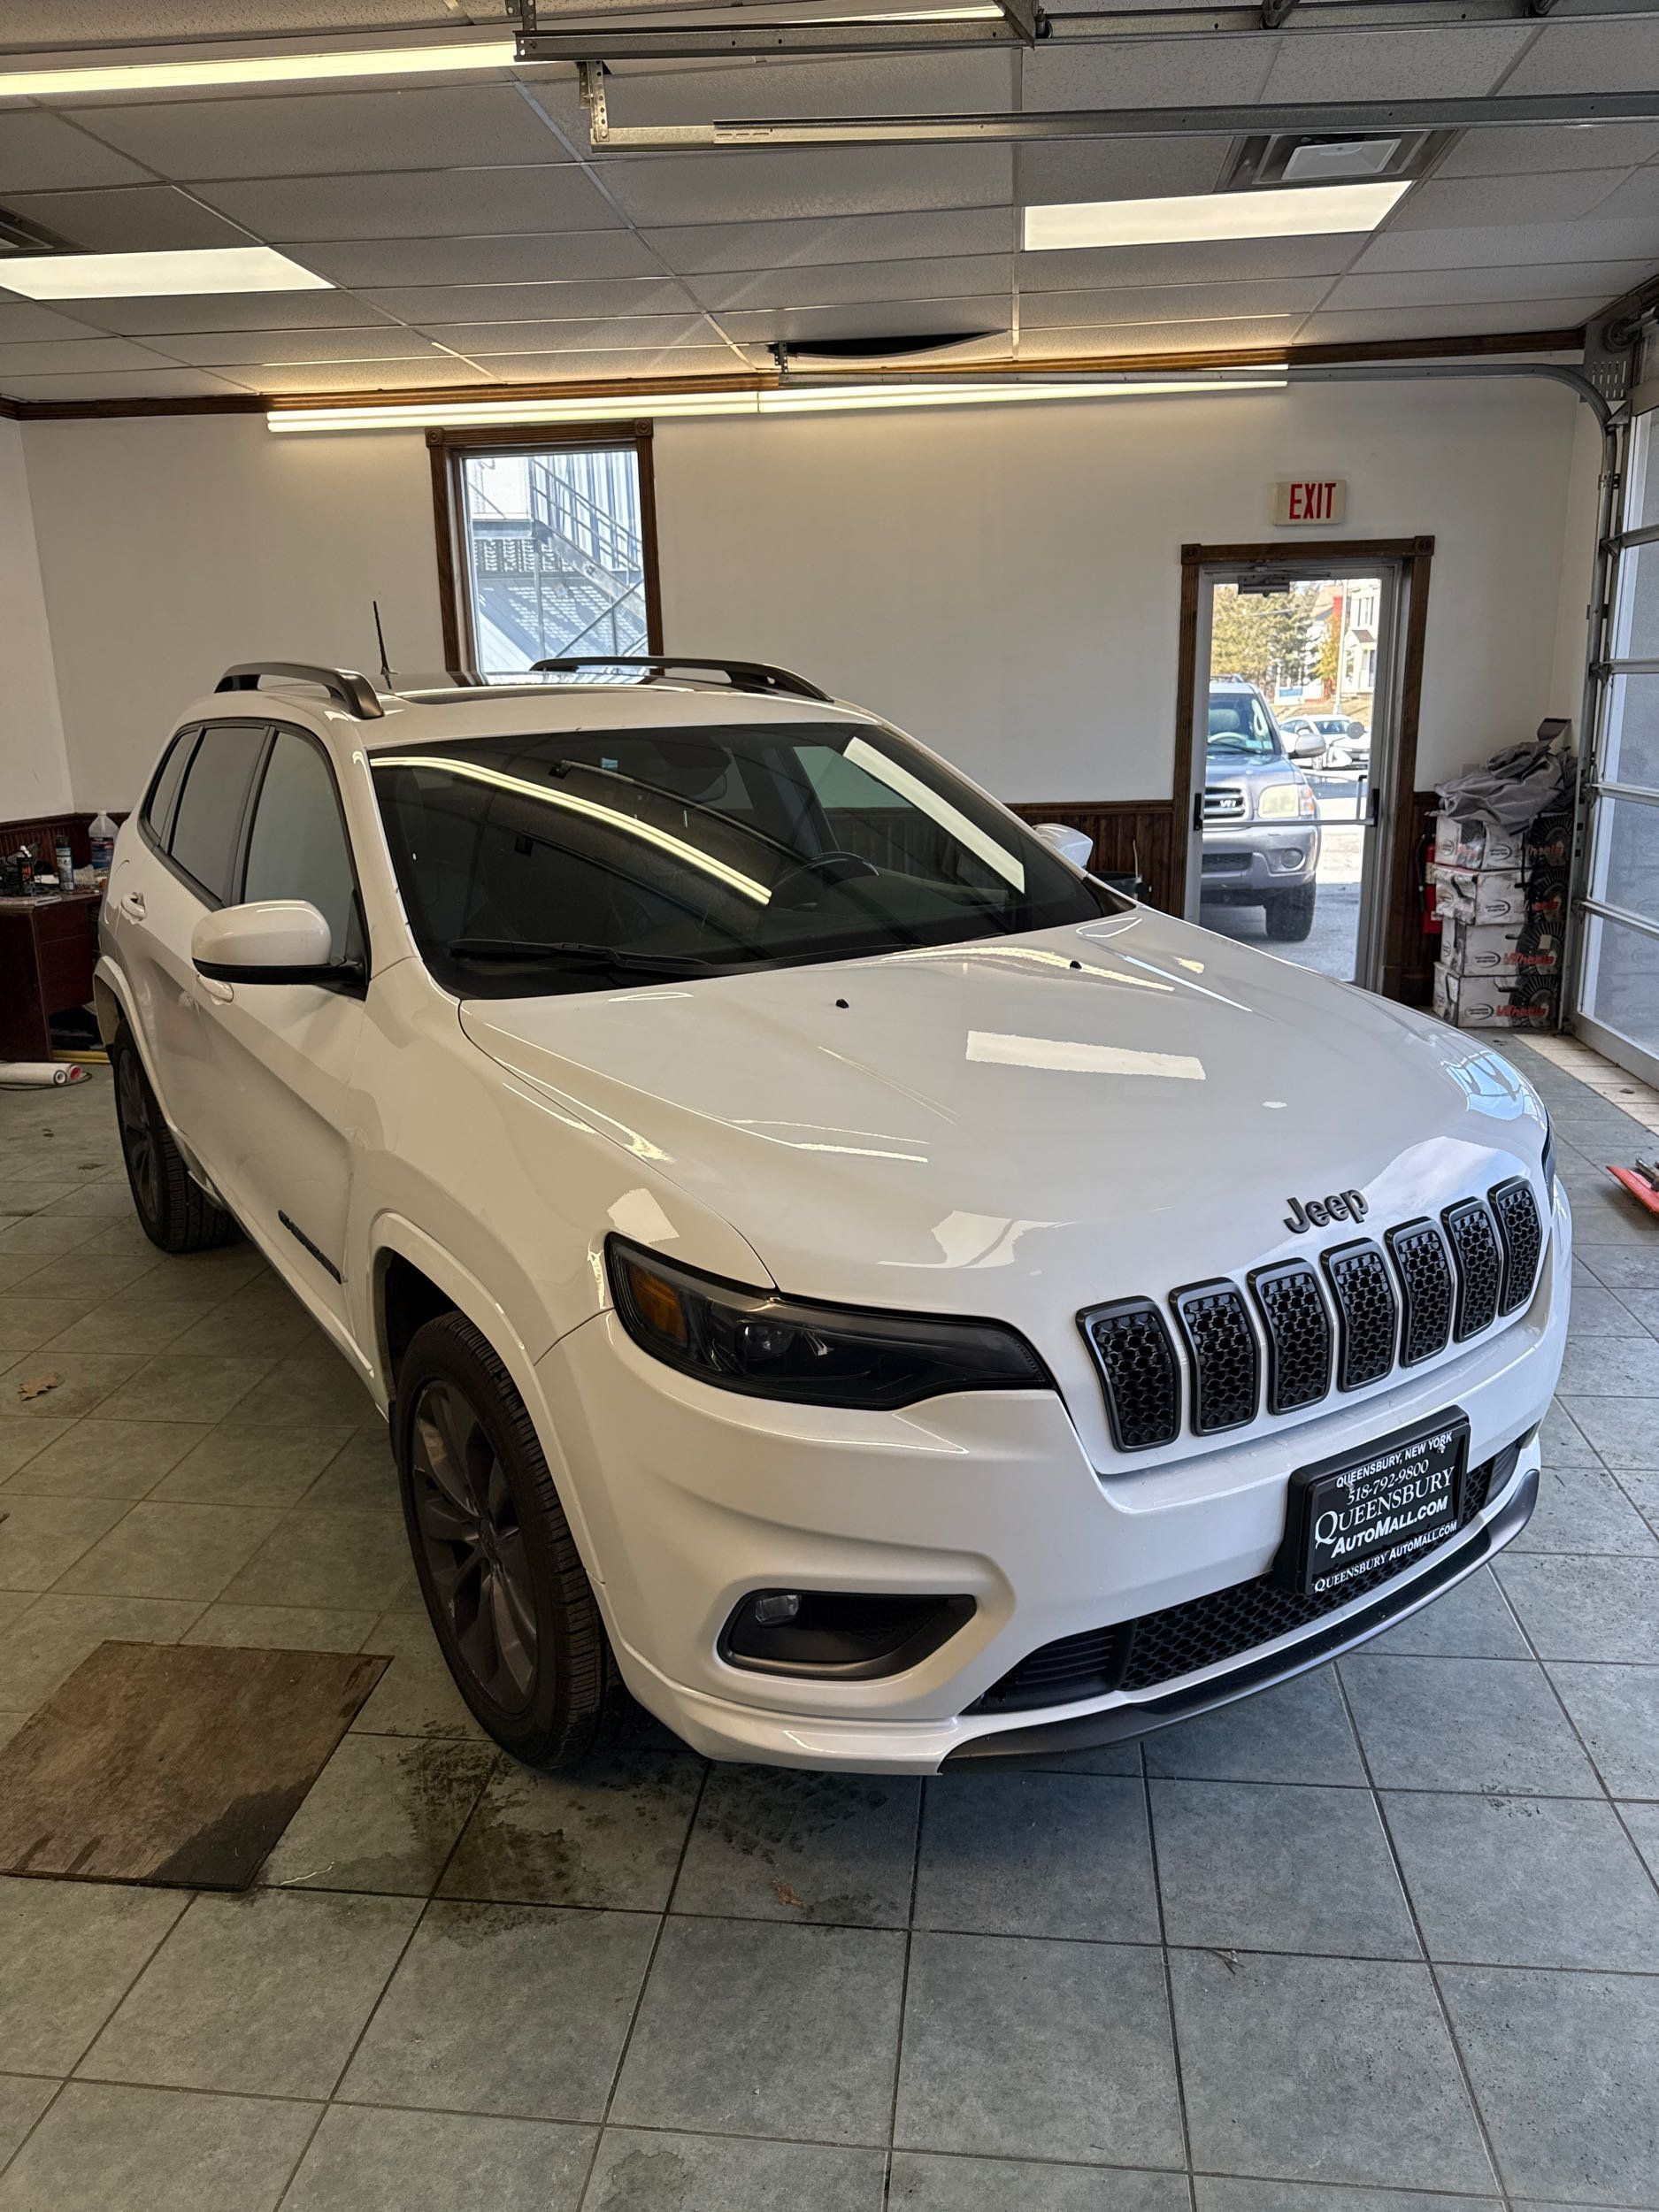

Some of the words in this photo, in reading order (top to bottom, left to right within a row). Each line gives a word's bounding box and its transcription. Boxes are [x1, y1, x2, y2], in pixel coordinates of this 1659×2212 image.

[1289, 483, 1336, 519] EXIT
[1283, 1189, 1369, 1234] Jeep
[1336, 1452, 1403, 1488] QUEENSBURY,
[1404, 1441, 1426, 1460] NEW
[1428, 1431, 1453, 1451] YORK
[1346, 1459, 1429, 1505] 518-792-9800
[1315, 1466, 1455, 1549] QUEENSBURY
[1331, 1495, 1448, 1558] AUTOMALL.COM
[1314, 1549, 1390, 1592] QUEENSBURY
[1389, 1519, 1458, 1561] AUTOMALL.COM
